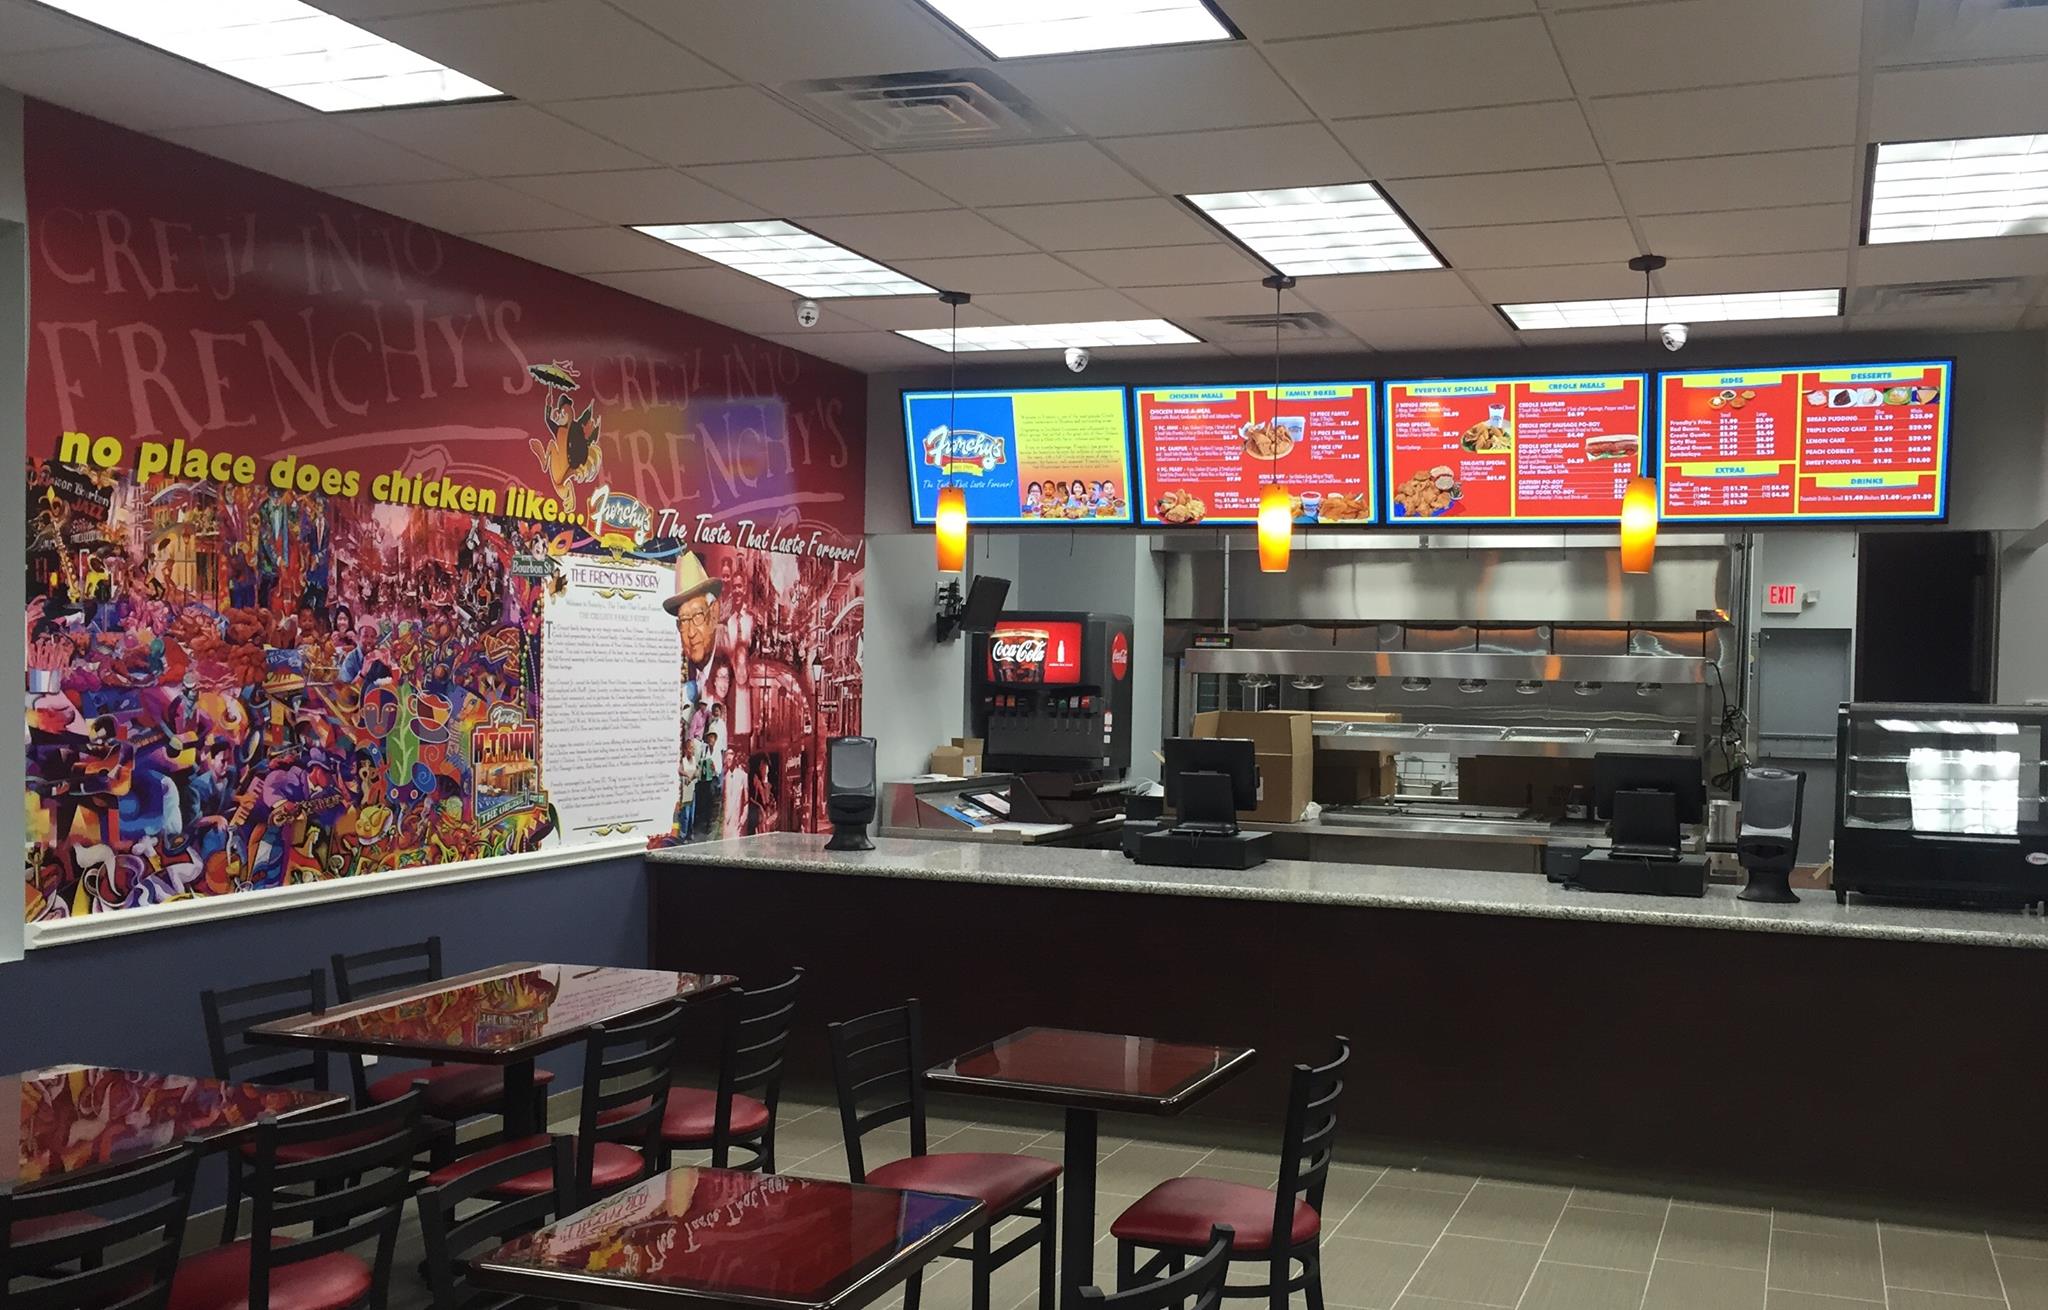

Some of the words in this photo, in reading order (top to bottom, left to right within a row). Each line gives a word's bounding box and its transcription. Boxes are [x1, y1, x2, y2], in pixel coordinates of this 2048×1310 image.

[297, 209, 443, 295] INTO
[36, 294, 534, 442] FRENCHY'S
[1851, 372, 1892, 380] DESSERTS
[598, 396, 849, 508] FRENCHY'S
[58, 431, 123, 468] no
[137, 439, 257, 485] place
[269, 454, 361, 497] does
[371, 470, 497, 514] chicken
[505, 486, 585, 526] like...
[655, 508, 687, 539] The
[694, 513, 731, 545] Taste
[735, 519, 769, 550] That
[770, 527, 806, 555] Lasts
[807, 531, 864, 564] Forever!
[513, 560, 543, 575] Bourbon
[571, 568, 588, 583] THE
[590, 570, 634, 587] FRENCHY'S
[636, 574, 660, 590] STORY
[1770, 585, 1796, 604] EXIT
[992, 639, 1048, 664] Coca-Cola
[480, 809, 498, 824] THE
